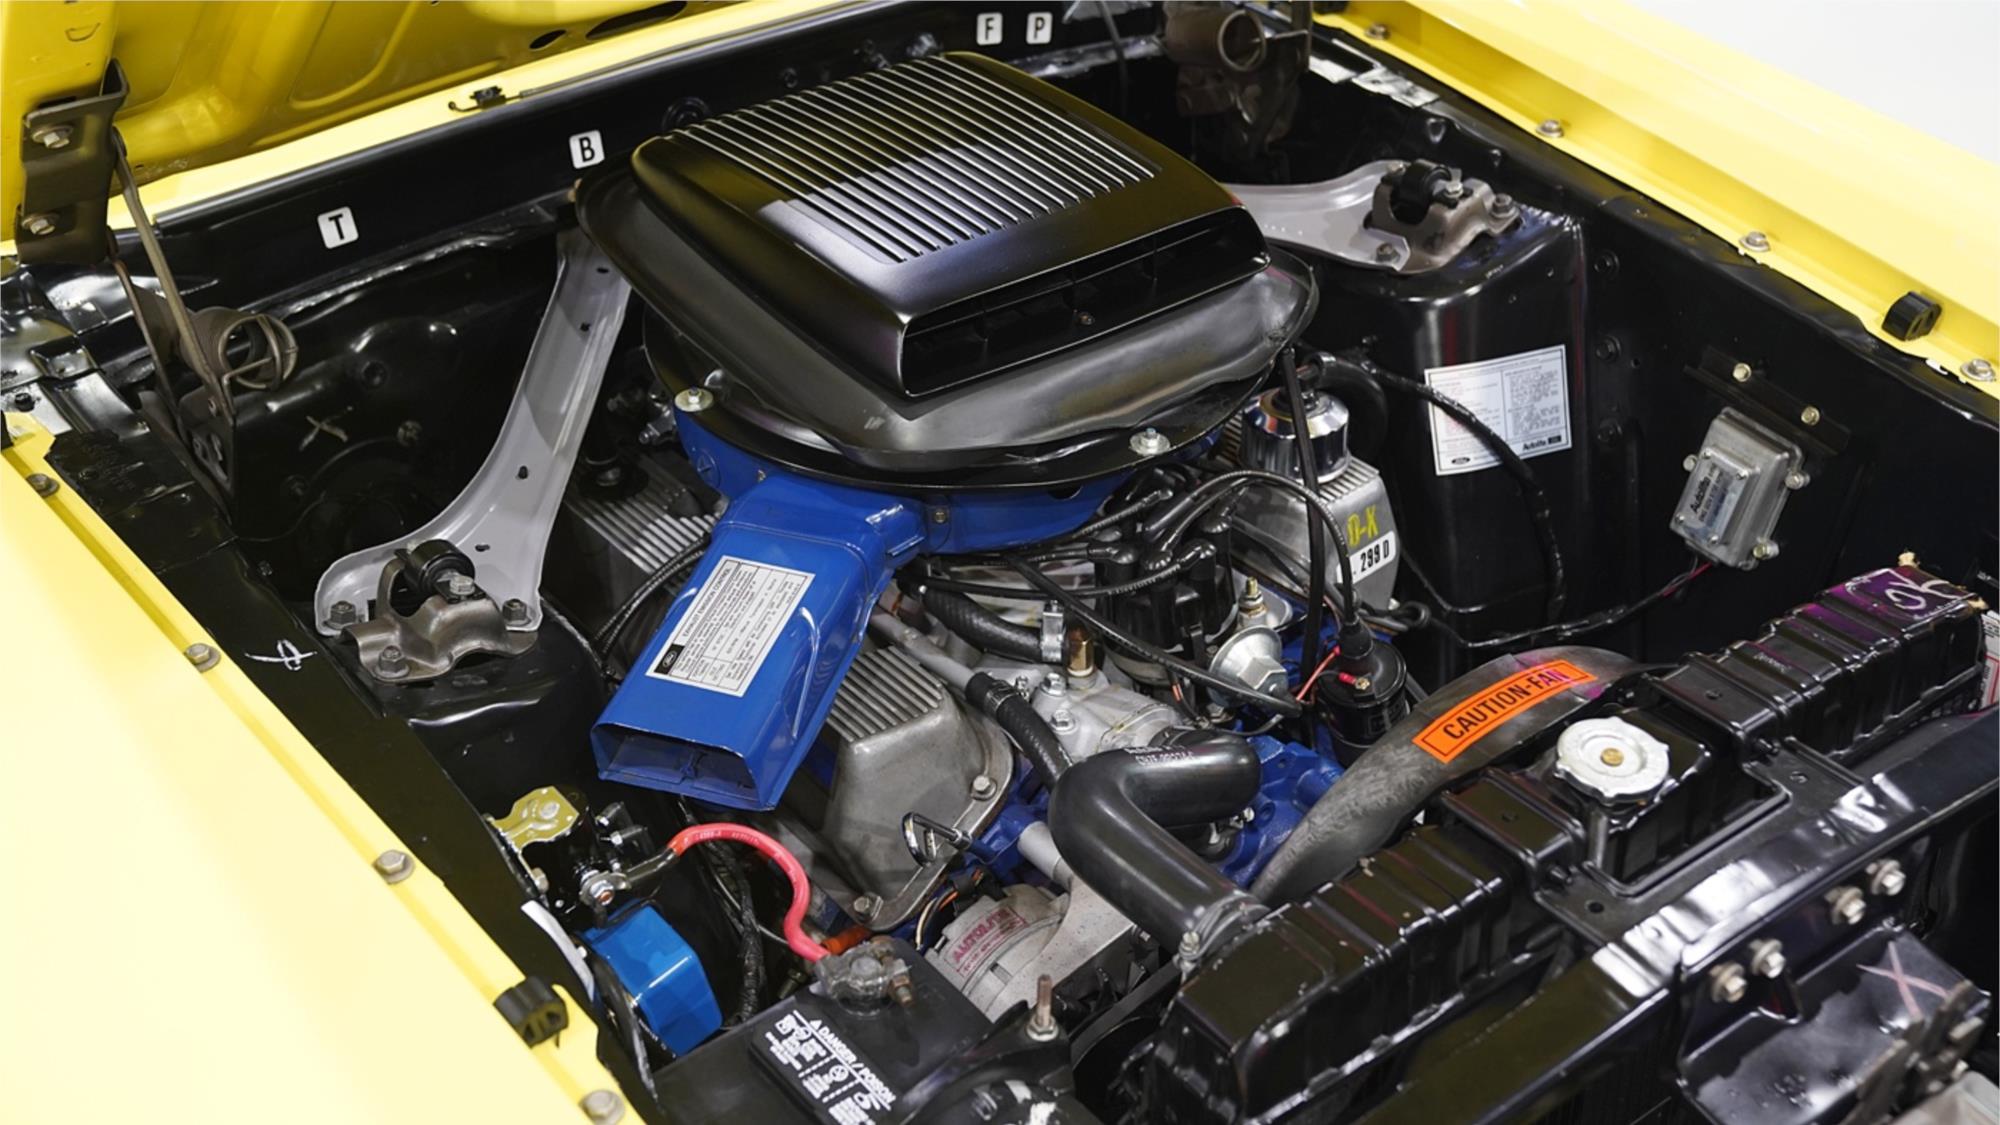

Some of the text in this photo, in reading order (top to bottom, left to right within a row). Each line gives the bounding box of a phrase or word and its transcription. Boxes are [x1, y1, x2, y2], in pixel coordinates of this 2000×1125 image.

[985, 17, 994, 40] F
[1034, 17, 1045, 40] P
[579, 136, 595, 162] B
[328, 213, 345, 240] T
[1360, 543, 1381, 573] 299
[1443, 668, 1570, 740] CAUTION-FAN
